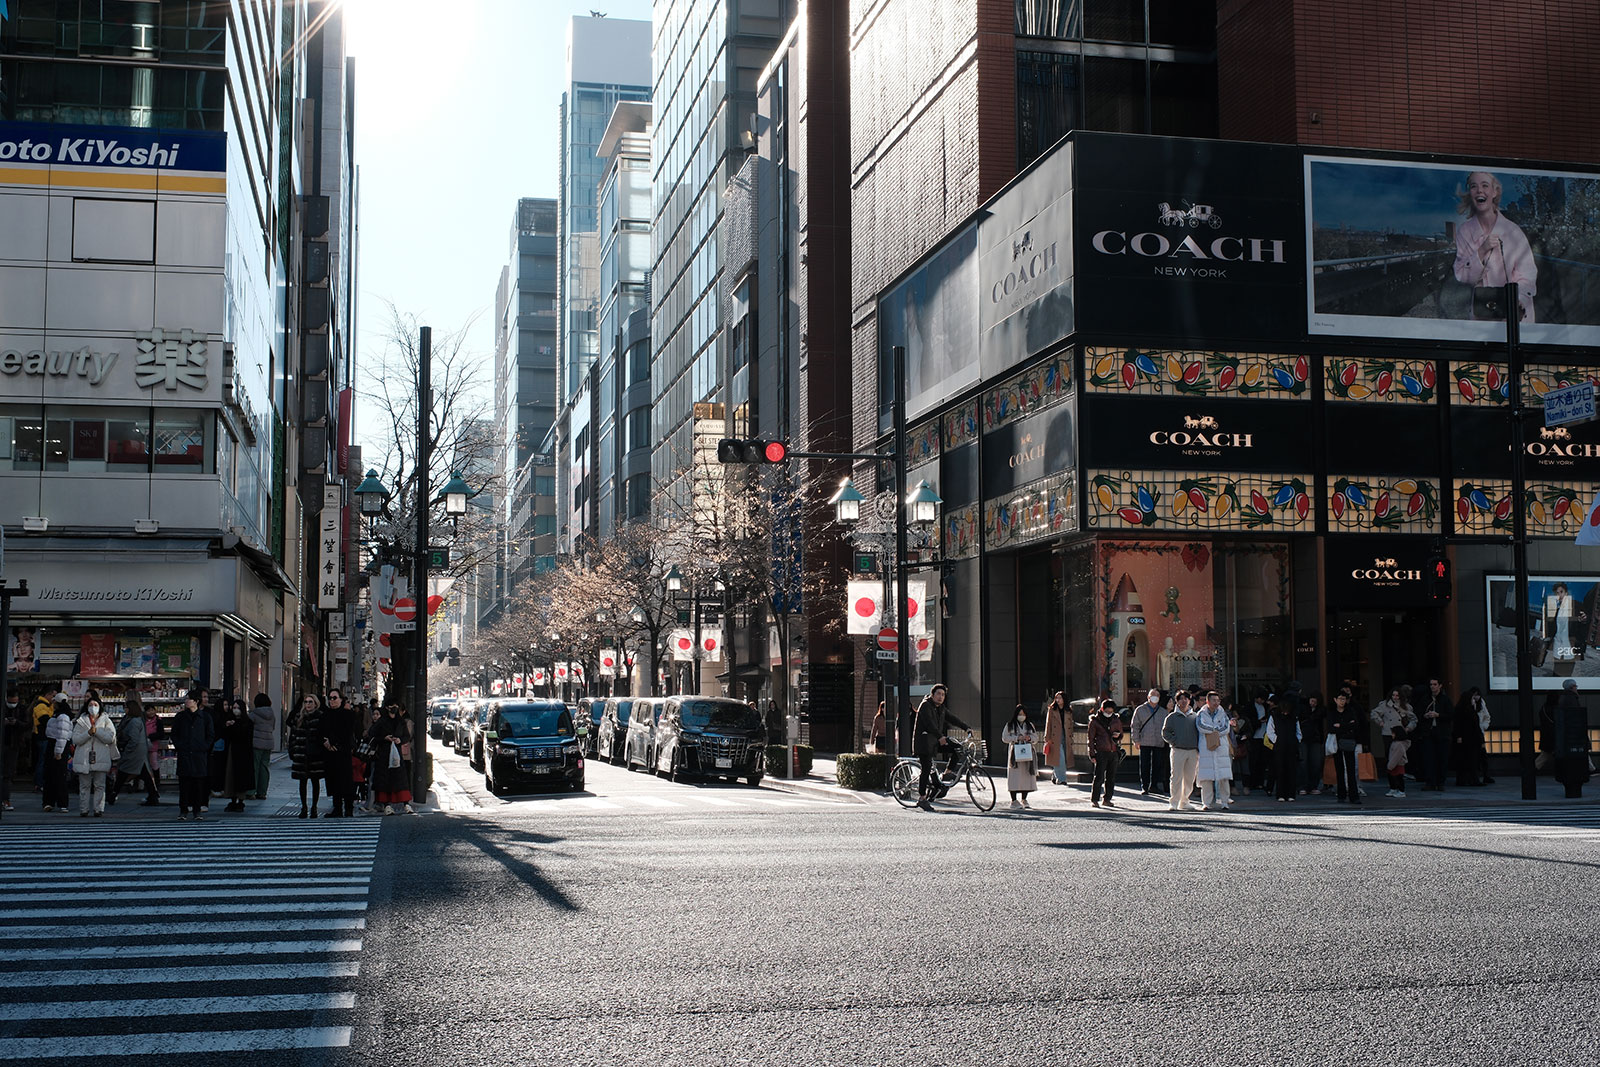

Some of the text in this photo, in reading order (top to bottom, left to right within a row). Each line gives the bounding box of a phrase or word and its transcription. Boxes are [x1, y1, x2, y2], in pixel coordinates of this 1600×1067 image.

[57, 138, 180, 167] KiYoshi
[1092, 230, 1287, 264] COACH
[991, 241, 1058, 305] COACH
[1154, 266, 1227, 278] NEW YORK
[0, 345, 119, 386] eauty
[135, 327, 209, 391] 薬
[1546, 387, 1592, 410] 並木通り口
[1149, 431, 1254, 448] COACH
[1009, 444, 1045, 469] COACH
[322, 520, 337, 596] 三笠會館
[432, 552, 442, 564] 5
[860, 557, 870, 568] 5
[1351, 568, 1422, 580] COACH
[37, 587, 194, 602] Matsumoto KiYoshi
